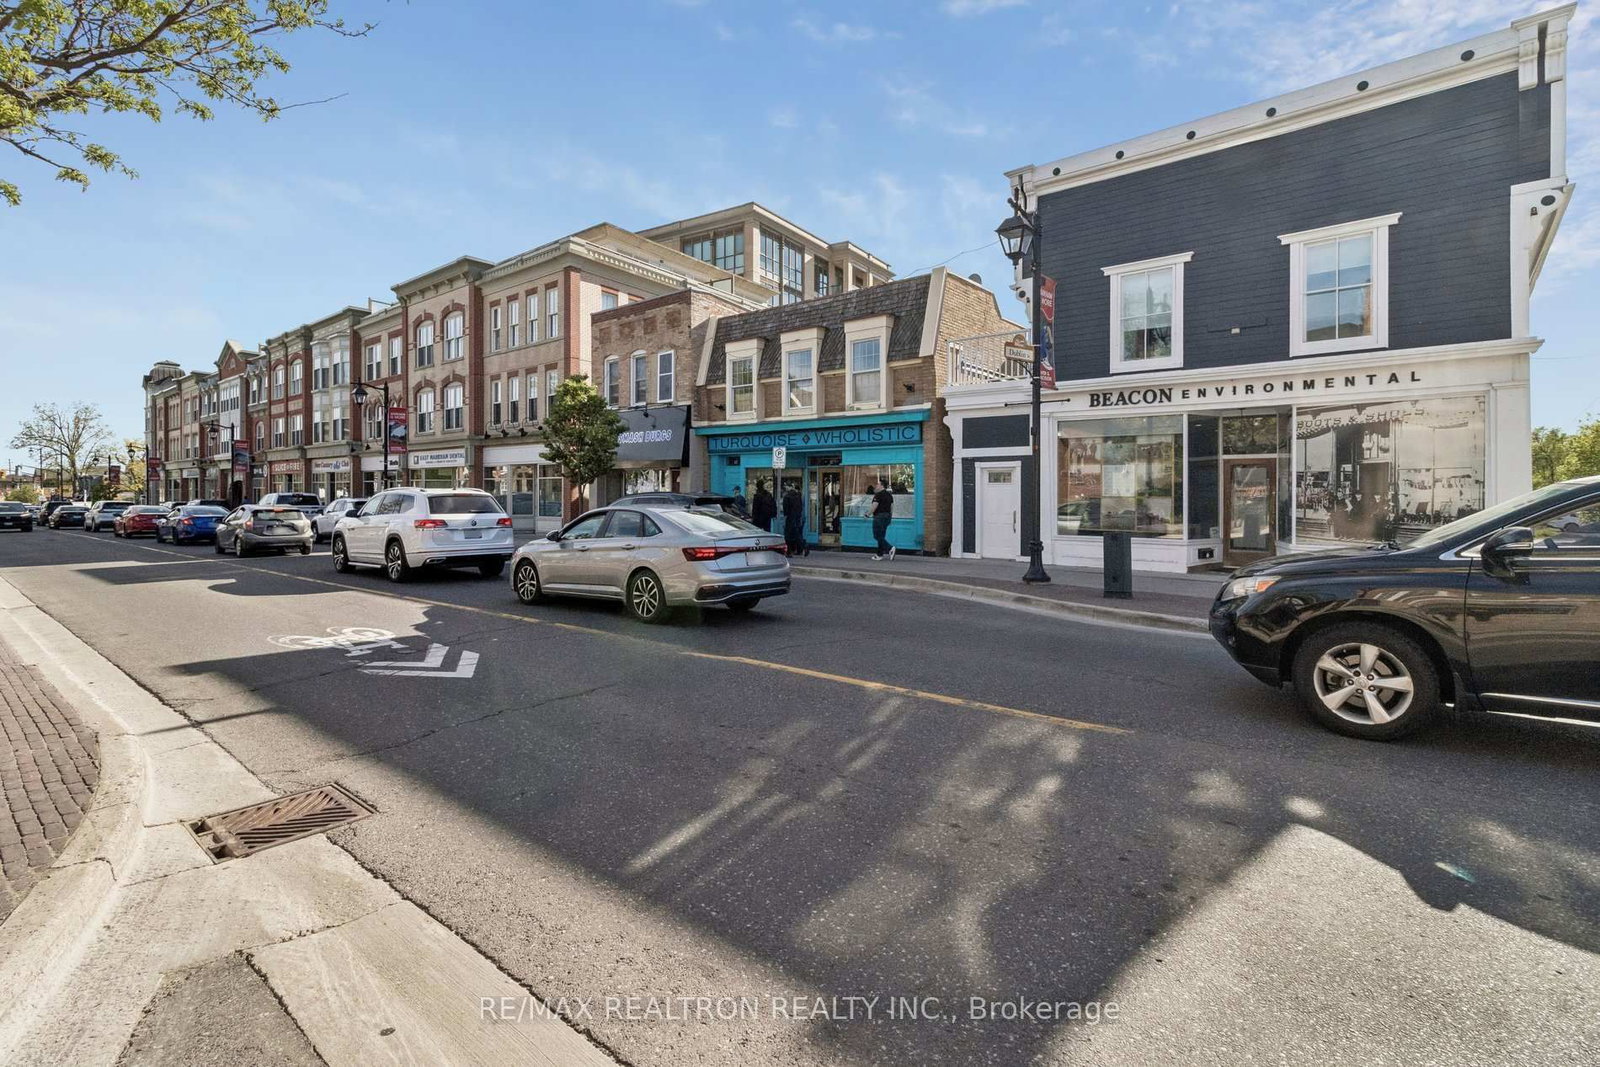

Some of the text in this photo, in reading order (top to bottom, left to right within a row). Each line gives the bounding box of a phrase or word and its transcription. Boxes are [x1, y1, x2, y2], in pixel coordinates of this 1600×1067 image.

[1089, 371, 1422, 407] BEACON ENVIRONMENTAL
[1296, 417, 1342, 430] BOOTS
[1348, 414, 1360, 424] &
[711, 426, 915, 449] TURQUOISE WHOLISTIC
